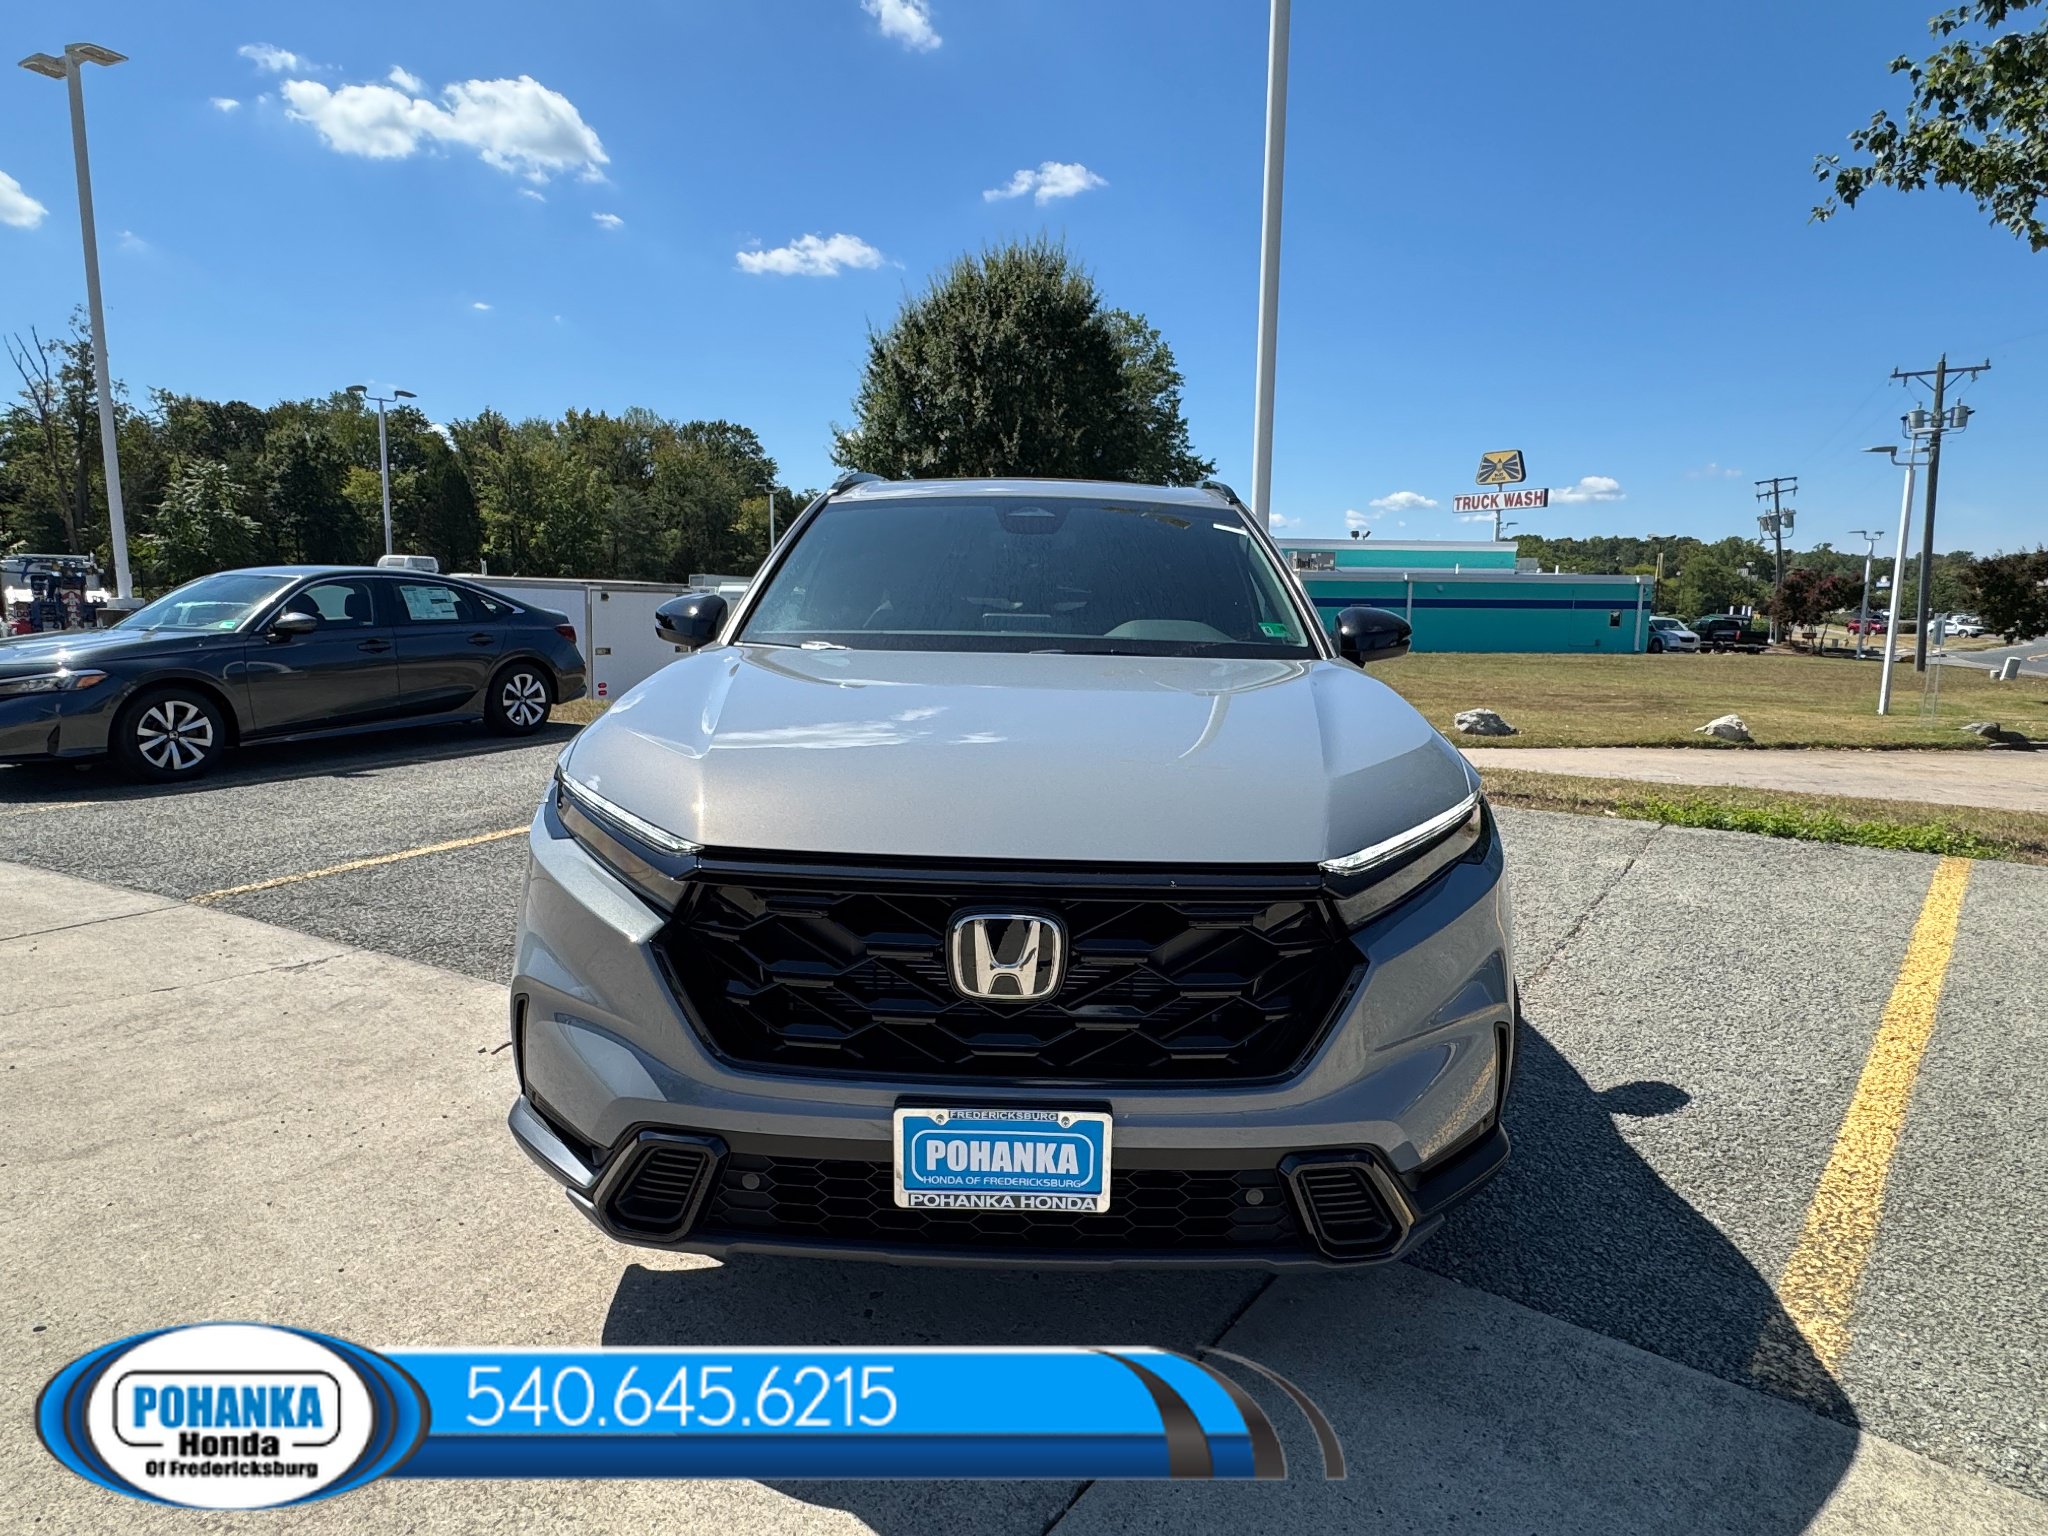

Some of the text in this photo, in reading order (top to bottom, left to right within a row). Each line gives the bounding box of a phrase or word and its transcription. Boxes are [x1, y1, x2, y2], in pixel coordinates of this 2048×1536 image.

[1455, 491, 1543, 510] TRUCK WASH
[950, 1111, 1058, 1121] FREDERICKSBURG
[926, 1139, 1079, 1175] POHANKA
[923, 1175, 1081, 1188] HONDA OF FREDERICKSBURG
[910, 1194, 1096, 1210] POHANKA HONDA
